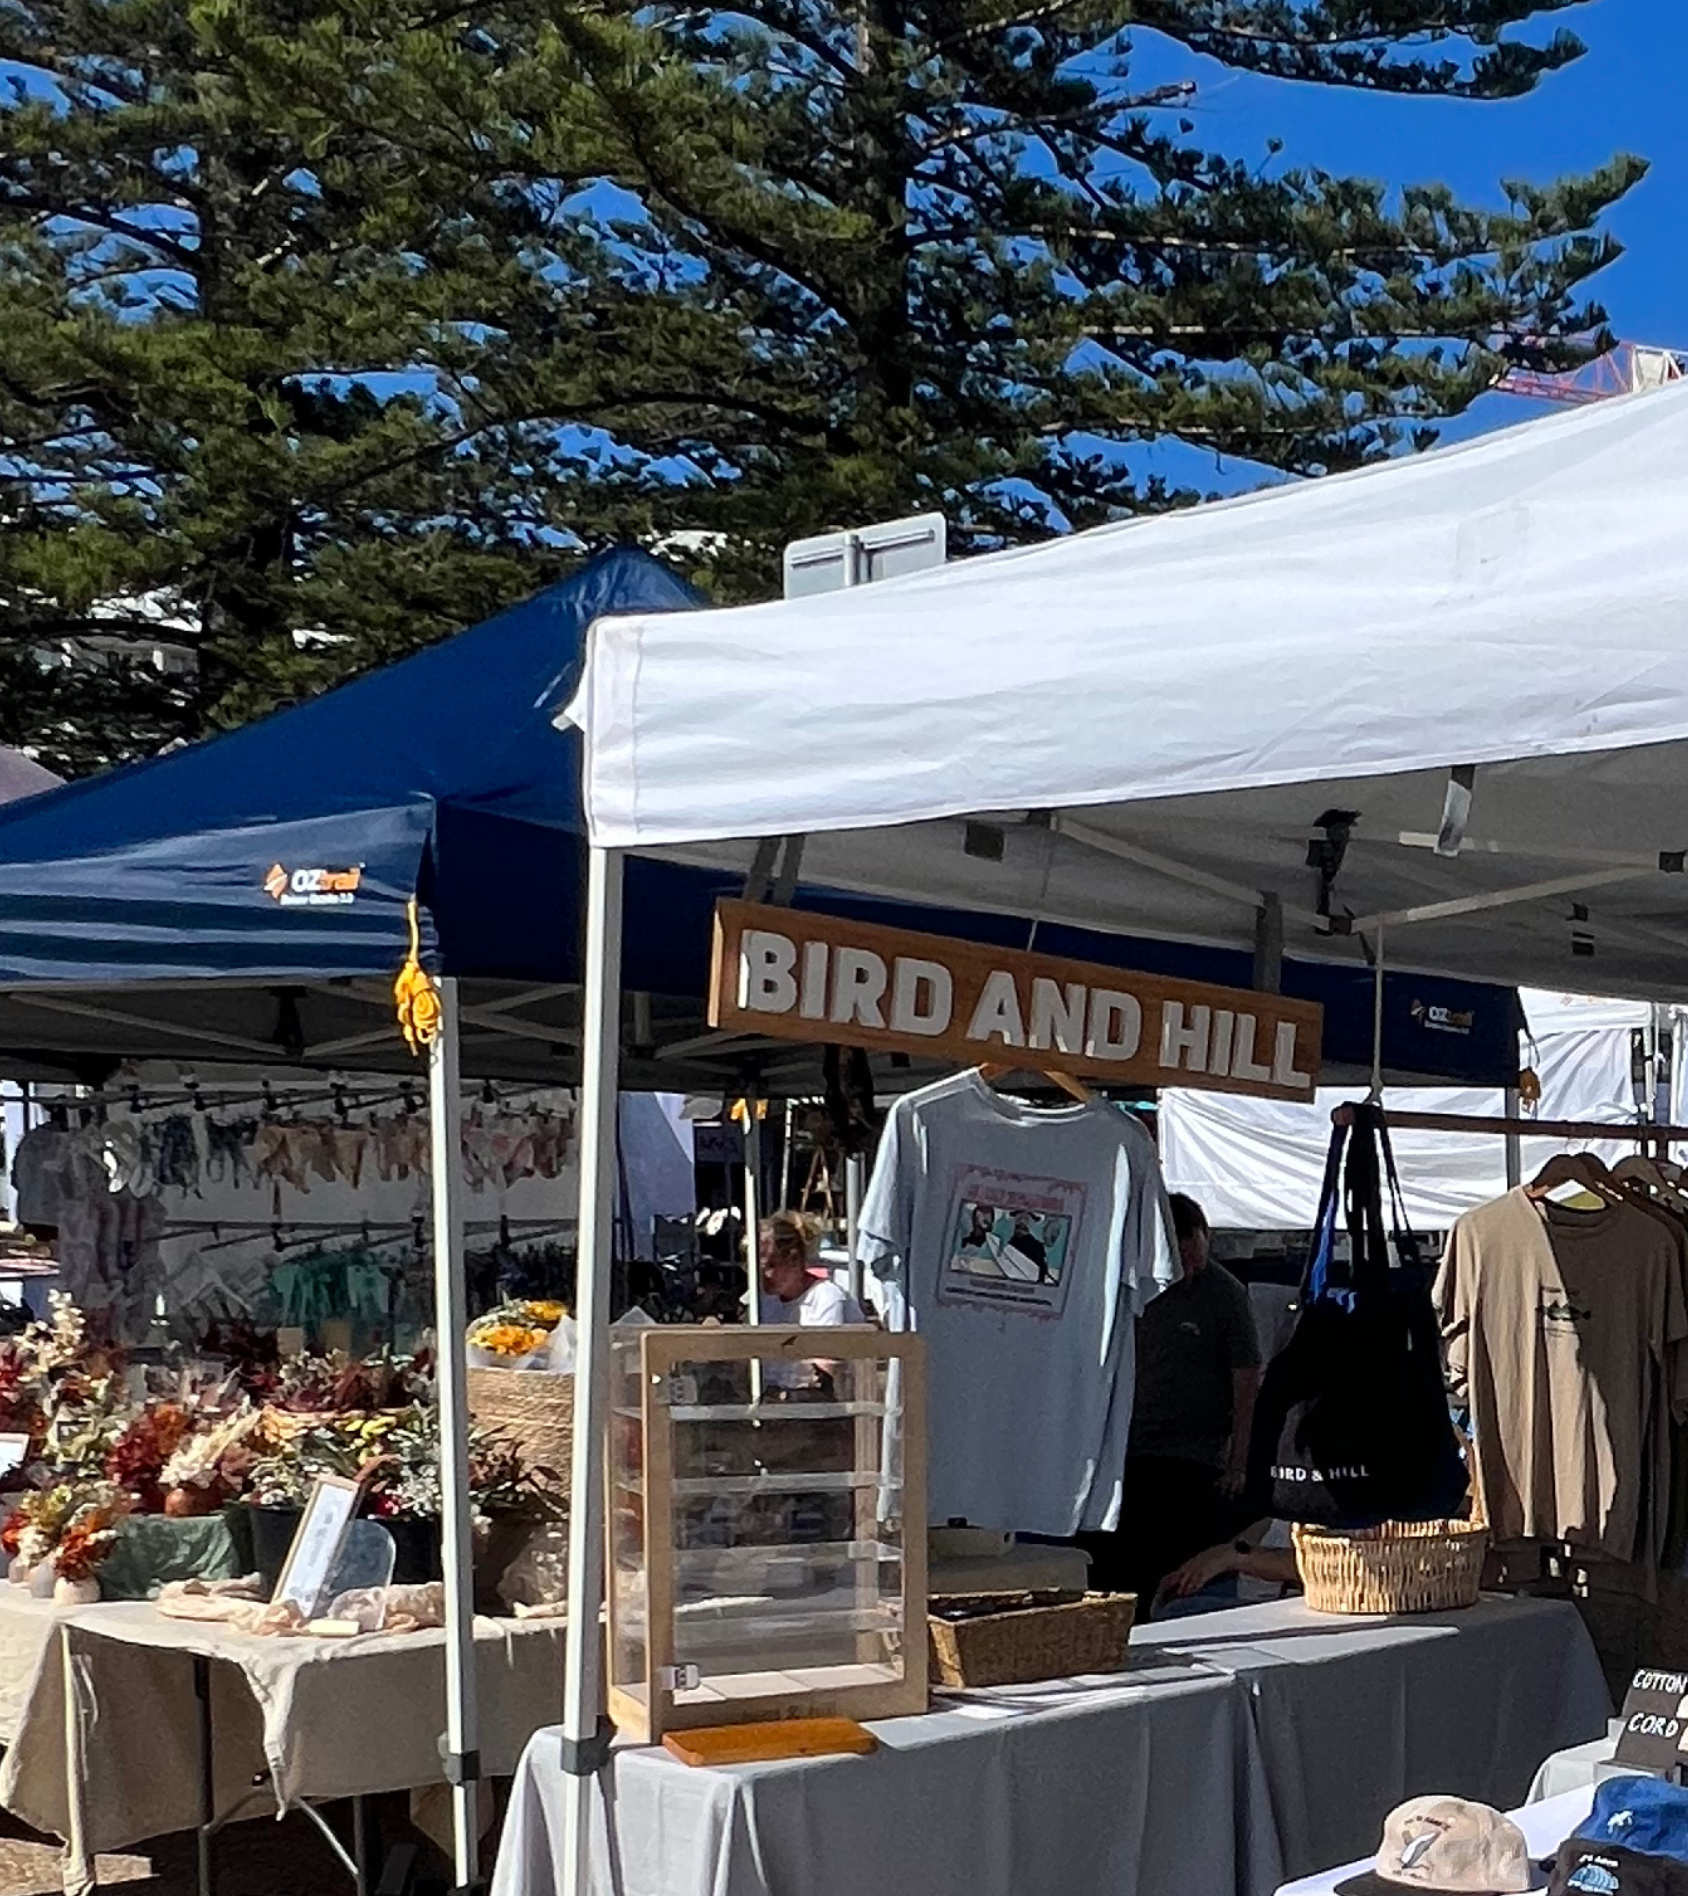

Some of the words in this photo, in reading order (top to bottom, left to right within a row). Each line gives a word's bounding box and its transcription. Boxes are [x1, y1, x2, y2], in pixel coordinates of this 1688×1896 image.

[737, 929, 953, 1037] BIRD
[965, 970, 1142, 1062] AND
[1157, 999, 1312, 1089] HILL
[1270, 1465, 1308, 1482] BIRD
[1310, 1468, 1324, 1483] &
[1328, 1464, 1370, 1480] HILL
[1627, 1712, 1679, 1738] CORD
